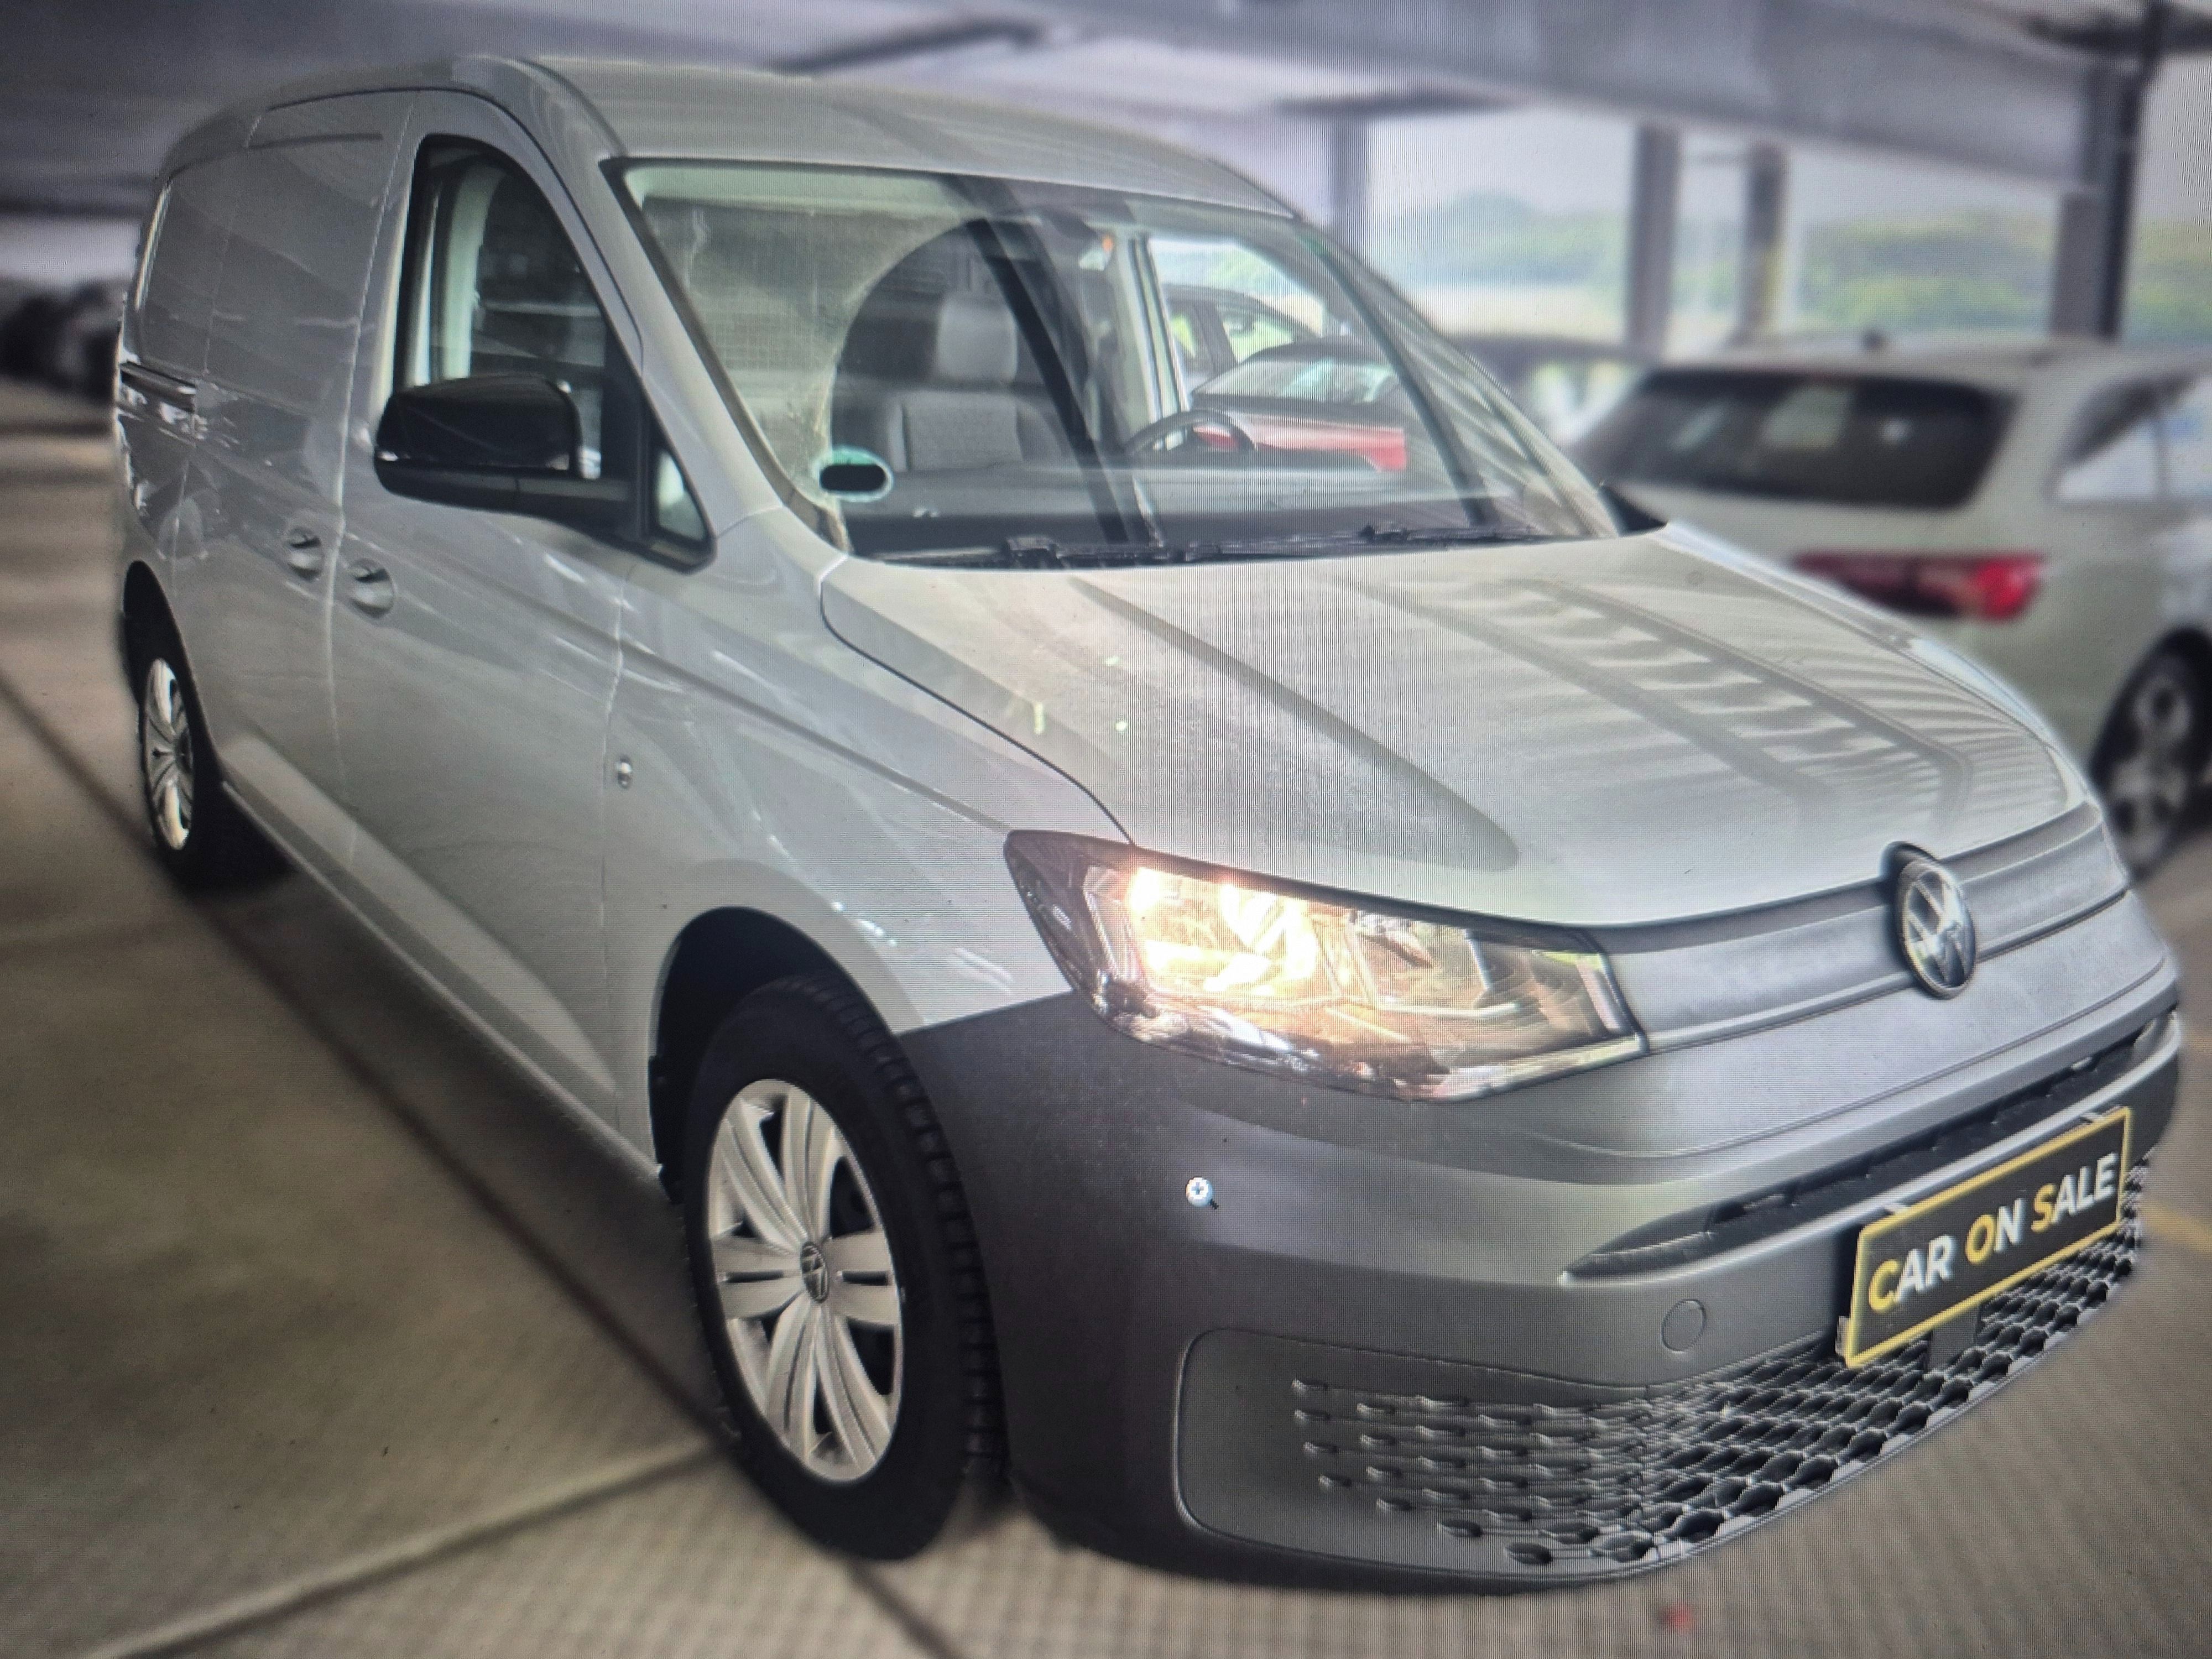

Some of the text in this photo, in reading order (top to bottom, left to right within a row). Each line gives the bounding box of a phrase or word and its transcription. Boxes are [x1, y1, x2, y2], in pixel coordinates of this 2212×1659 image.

[1869, 1152, 2119, 1313] CAR ON SALE
